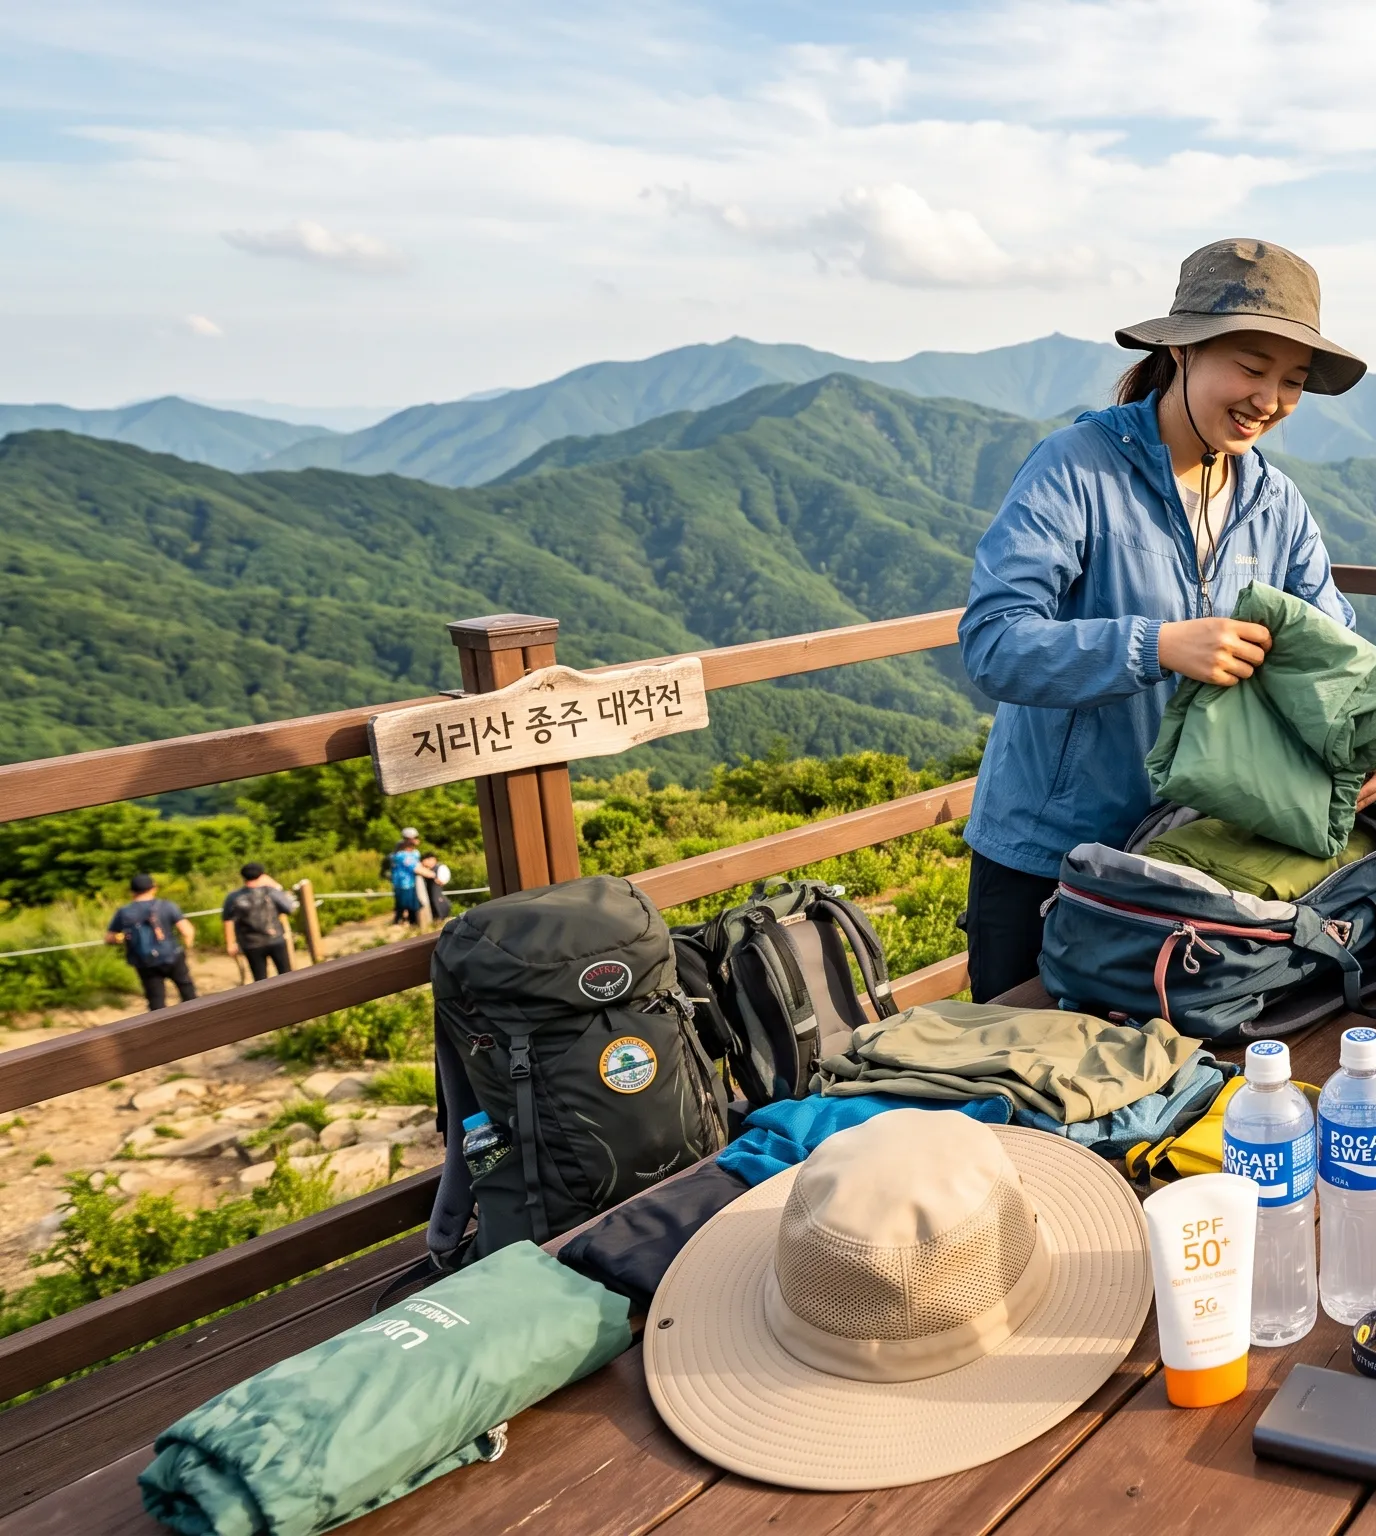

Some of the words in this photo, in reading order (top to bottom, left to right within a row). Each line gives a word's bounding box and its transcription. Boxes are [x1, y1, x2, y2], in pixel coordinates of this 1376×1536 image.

[412, 711, 515, 763] 지리산
[525, 700, 589, 745] 종주
[597, 680, 684, 727] 대작전
[1223, 1139, 1284, 1167] POCARI
[1182, 1217, 1224, 1240] SPF
[1184, 1237, 1231, 1271] 50+
